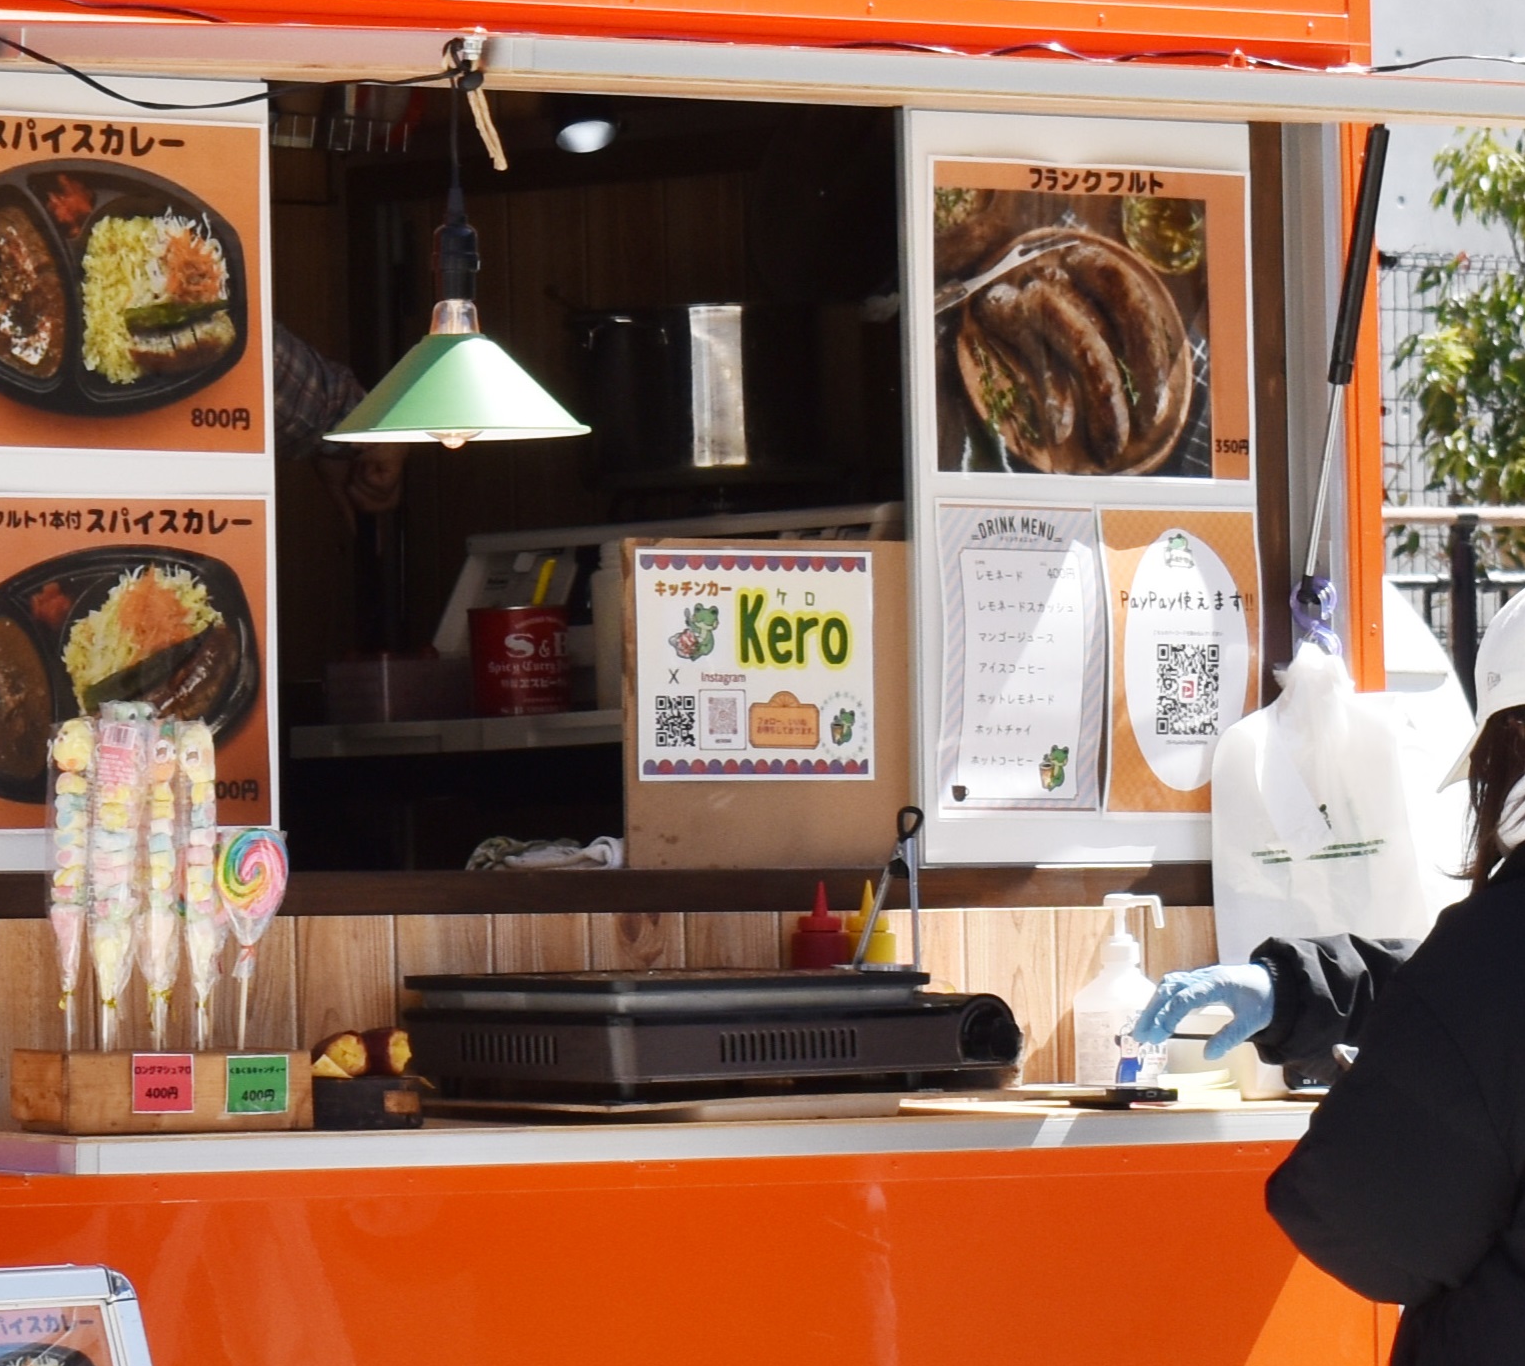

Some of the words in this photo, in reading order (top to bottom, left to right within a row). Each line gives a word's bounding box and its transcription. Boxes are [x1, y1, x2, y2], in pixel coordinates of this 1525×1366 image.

[1029, 168, 1164, 194] フランクフルト
[191, 408, 250, 431] 800円
[1215, 438, 1249, 456] 350円
[86, 508, 253, 535] スパイスカレー
[978, 516, 1016, 539] DRINK
[1021, 516, 1055, 541] MENU
[976, 570, 1023, 581] レモネード
[655, 580, 732, 597] キッチンカー
[978, 601, 1074, 613] レモネードスカッシュ
[740, 593, 849, 665] Kero
[979, 632, 1055, 643] マンゴージュース
[979, 662, 1046, 674] アイスコーヒー
[668, 669, 679, 684] X
[701, 672, 746, 685] Instagram
[977, 694, 1055, 705] ホットレモネード
[975, 725, 1032, 735] ホットチャイ
[971, 756, 1034, 766] ホットコーヒー
[135, 1065, 191, 1075] ロングマシュマロ
[145, 1087, 178, 1099] 400円
[242, 1089, 275, 1102] 400円
